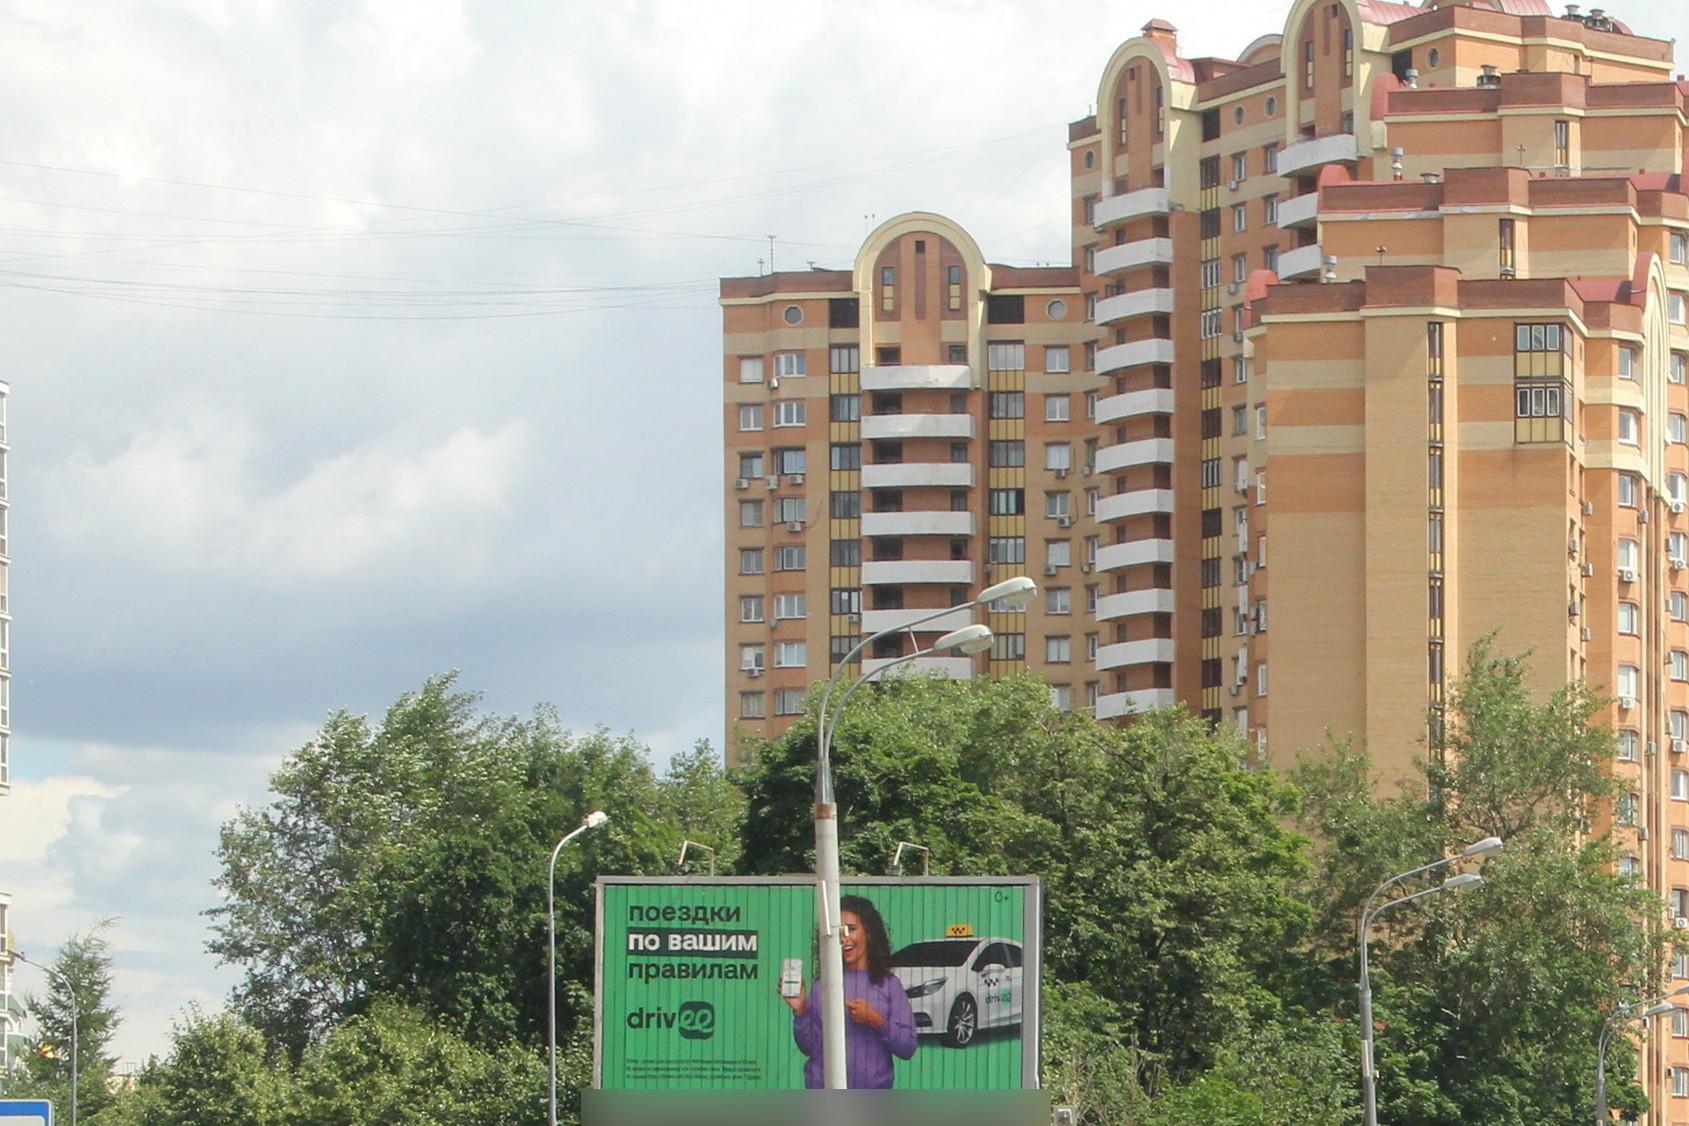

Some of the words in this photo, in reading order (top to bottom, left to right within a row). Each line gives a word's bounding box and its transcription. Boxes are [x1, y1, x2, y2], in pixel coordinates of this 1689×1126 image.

[994, 891, 1009, 903] 0+
[629, 905, 741, 925] поездки
[628, 933, 661, 951] по
[667, 933, 757, 952] вашим
[628, 962, 758, 985] правилам
[627, 1003, 714, 1037] drivee
